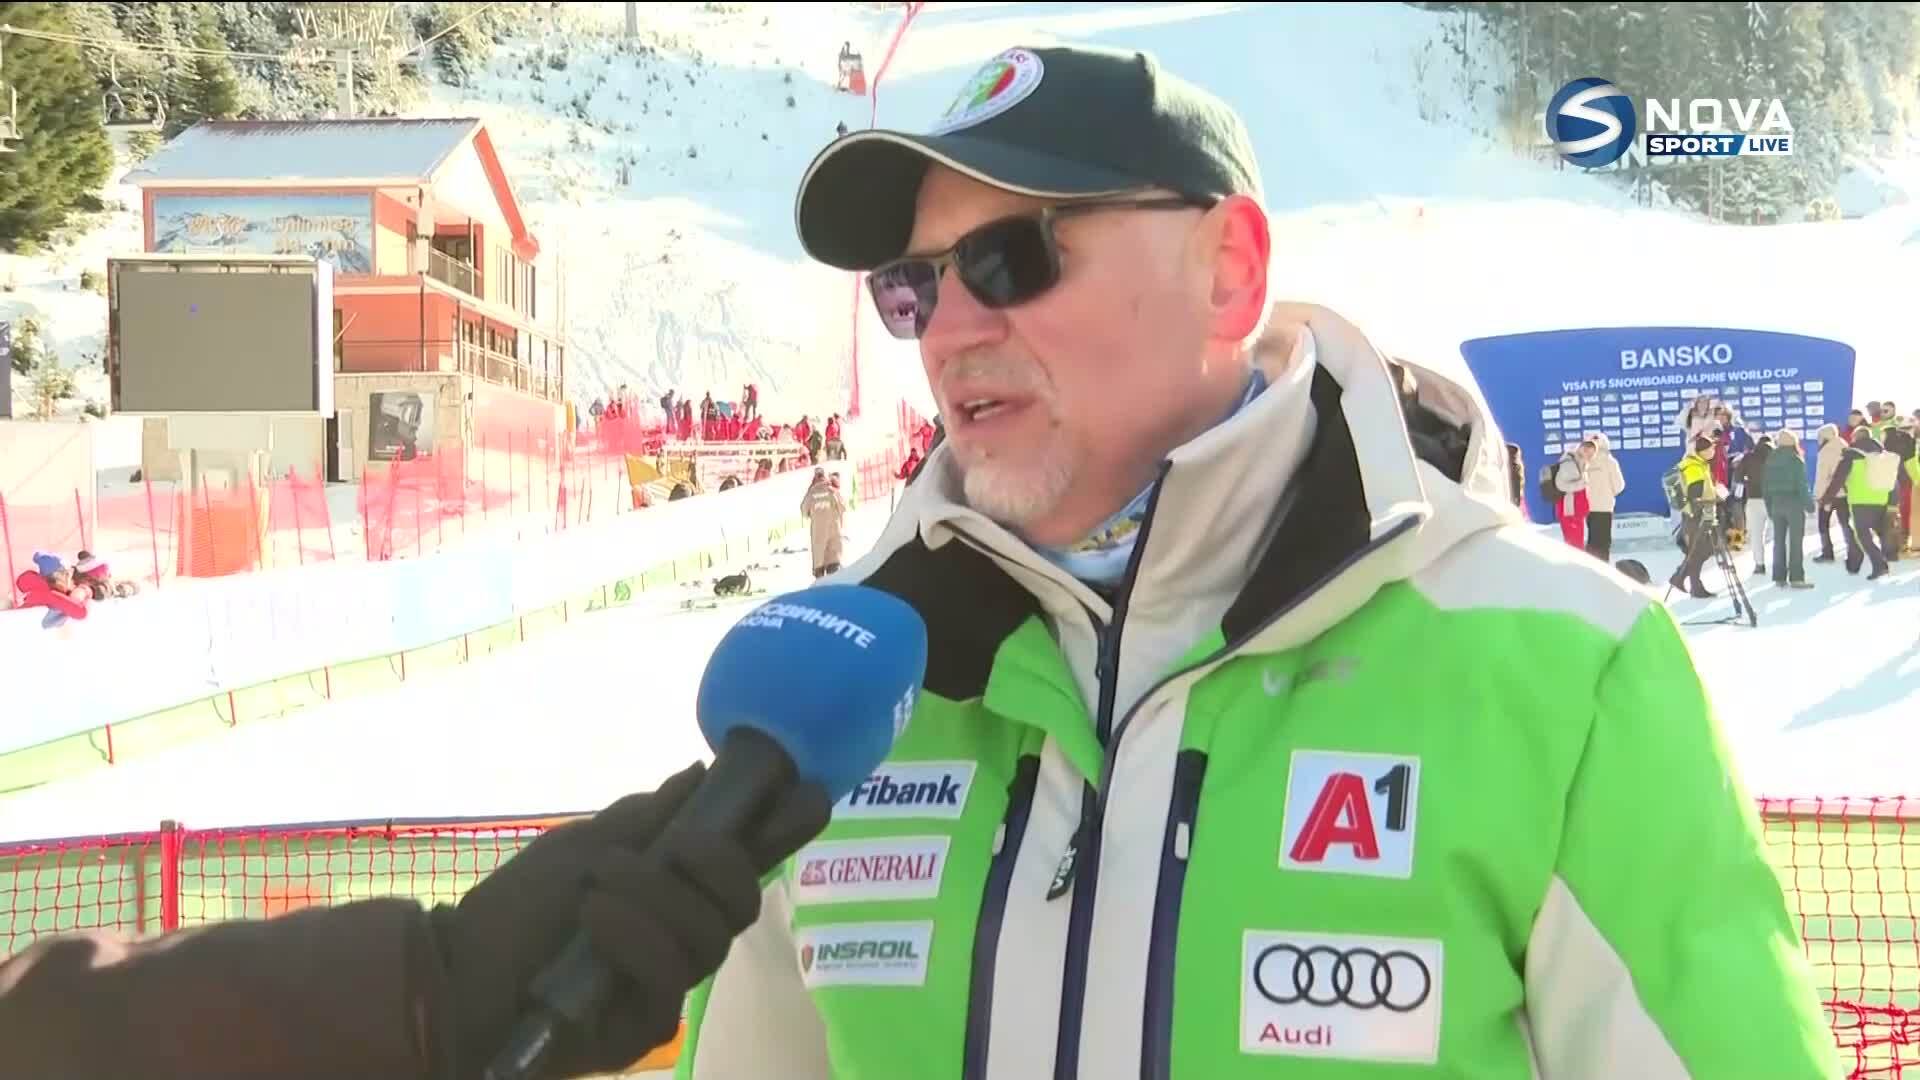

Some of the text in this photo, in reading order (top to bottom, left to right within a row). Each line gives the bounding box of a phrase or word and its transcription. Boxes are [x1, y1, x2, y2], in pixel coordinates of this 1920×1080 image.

[1620, 343, 1733, 370] BANSKO
[1562, 367, 1799, 392] VISA FIS SNOWBOARD ALPINE WORLD CUP
[849, 773, 961, 807] Fibank
[1288, 763, 1412, 863] A1
[829, 853, 937, 884] GENERALI
[1259, 1022, 1332, 1047] Audi
